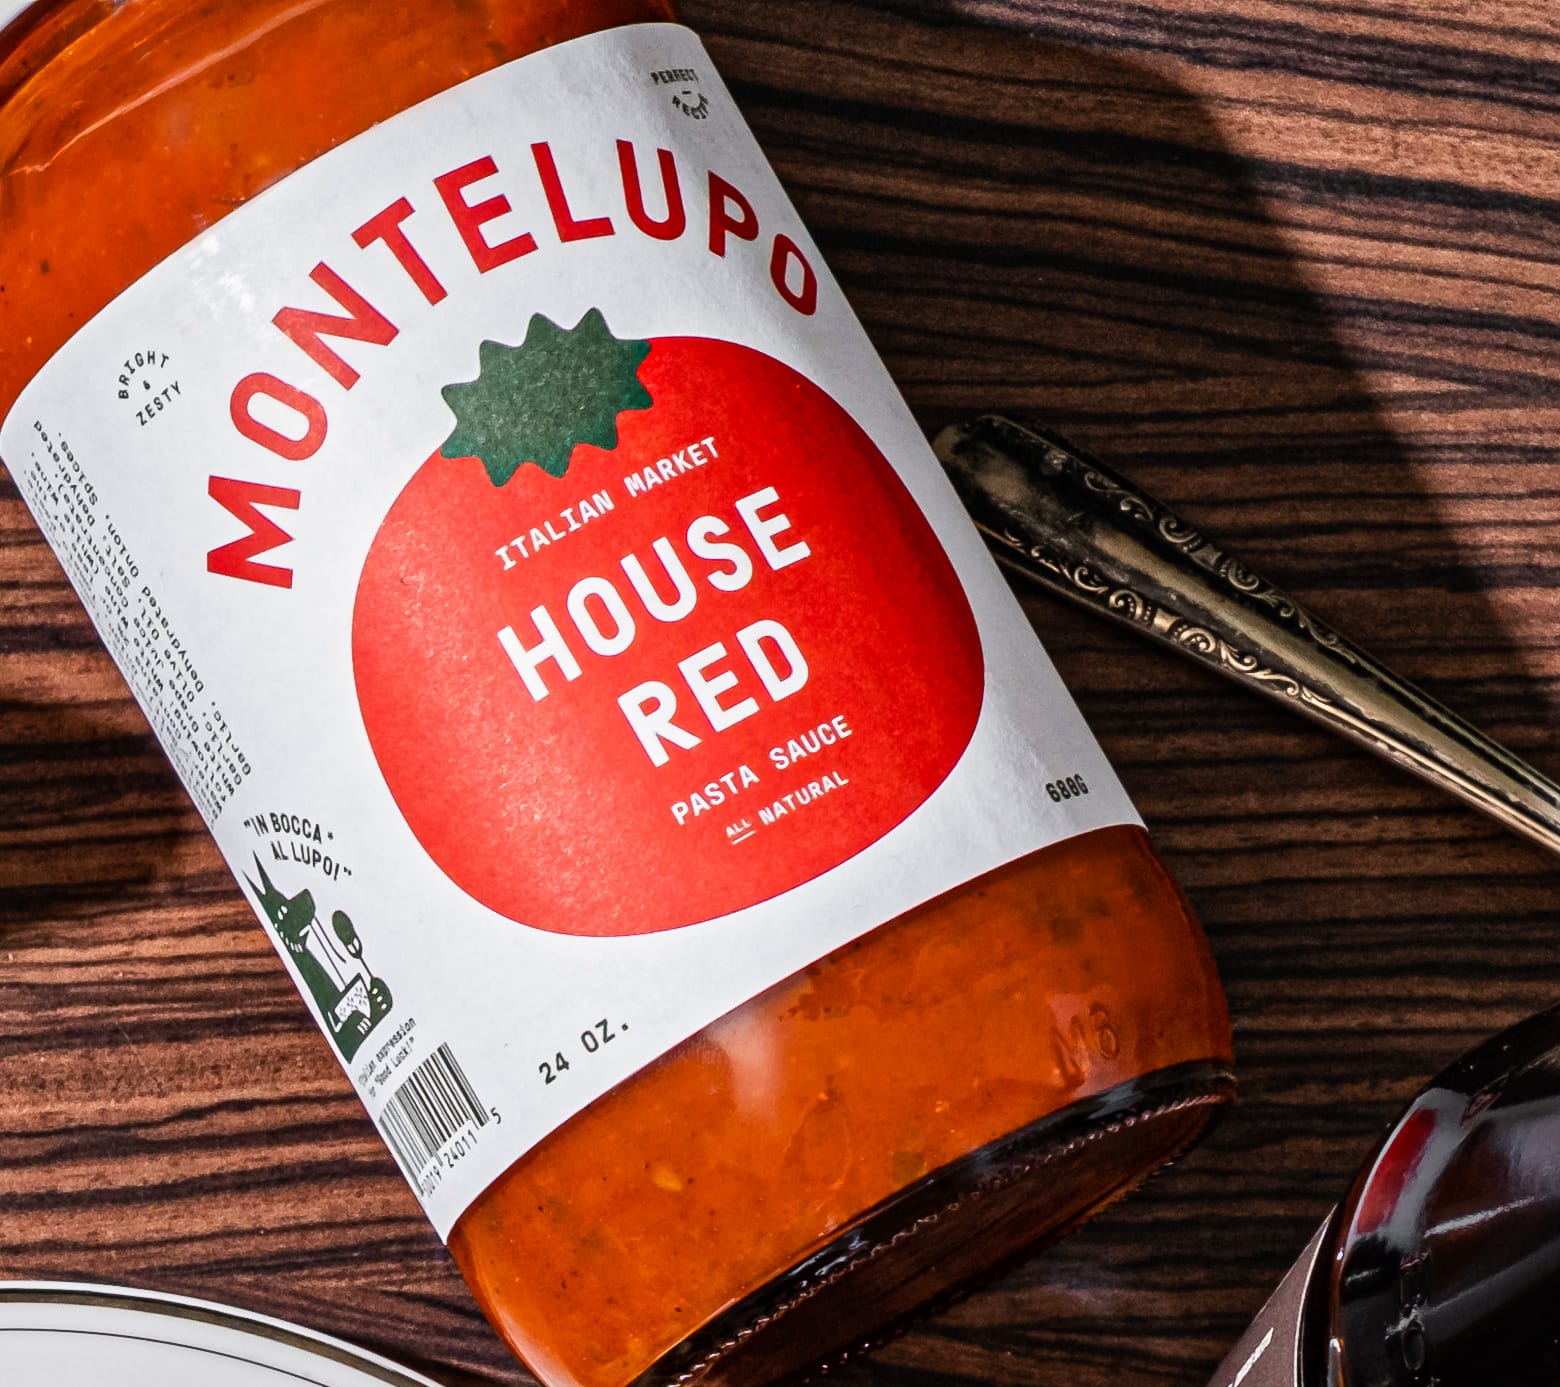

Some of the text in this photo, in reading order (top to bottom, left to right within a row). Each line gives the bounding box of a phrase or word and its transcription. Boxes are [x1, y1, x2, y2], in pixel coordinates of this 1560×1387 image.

[117, 350, 171, 400] BRIGHT
[207, 138, 818, 589] MONTELUPO
[135, 380, 181, 426] ZESTY
[496, 436, 719, 571] ITALIAN MARKET
[497, 486, 811, 702] HOUSE
[617, 618, 809, 768] RED
[670, 715, 852, 826] PASTA SAUCE
[270, 812, 322, 845] BOCCA
[725, 770, 848, 841] ALL NATURAL
[270, 841, 289, 862] AL
[538, 1018, 629, 1085] 24 OZ.
[443, 1107, 502, 1169] 24011 5
